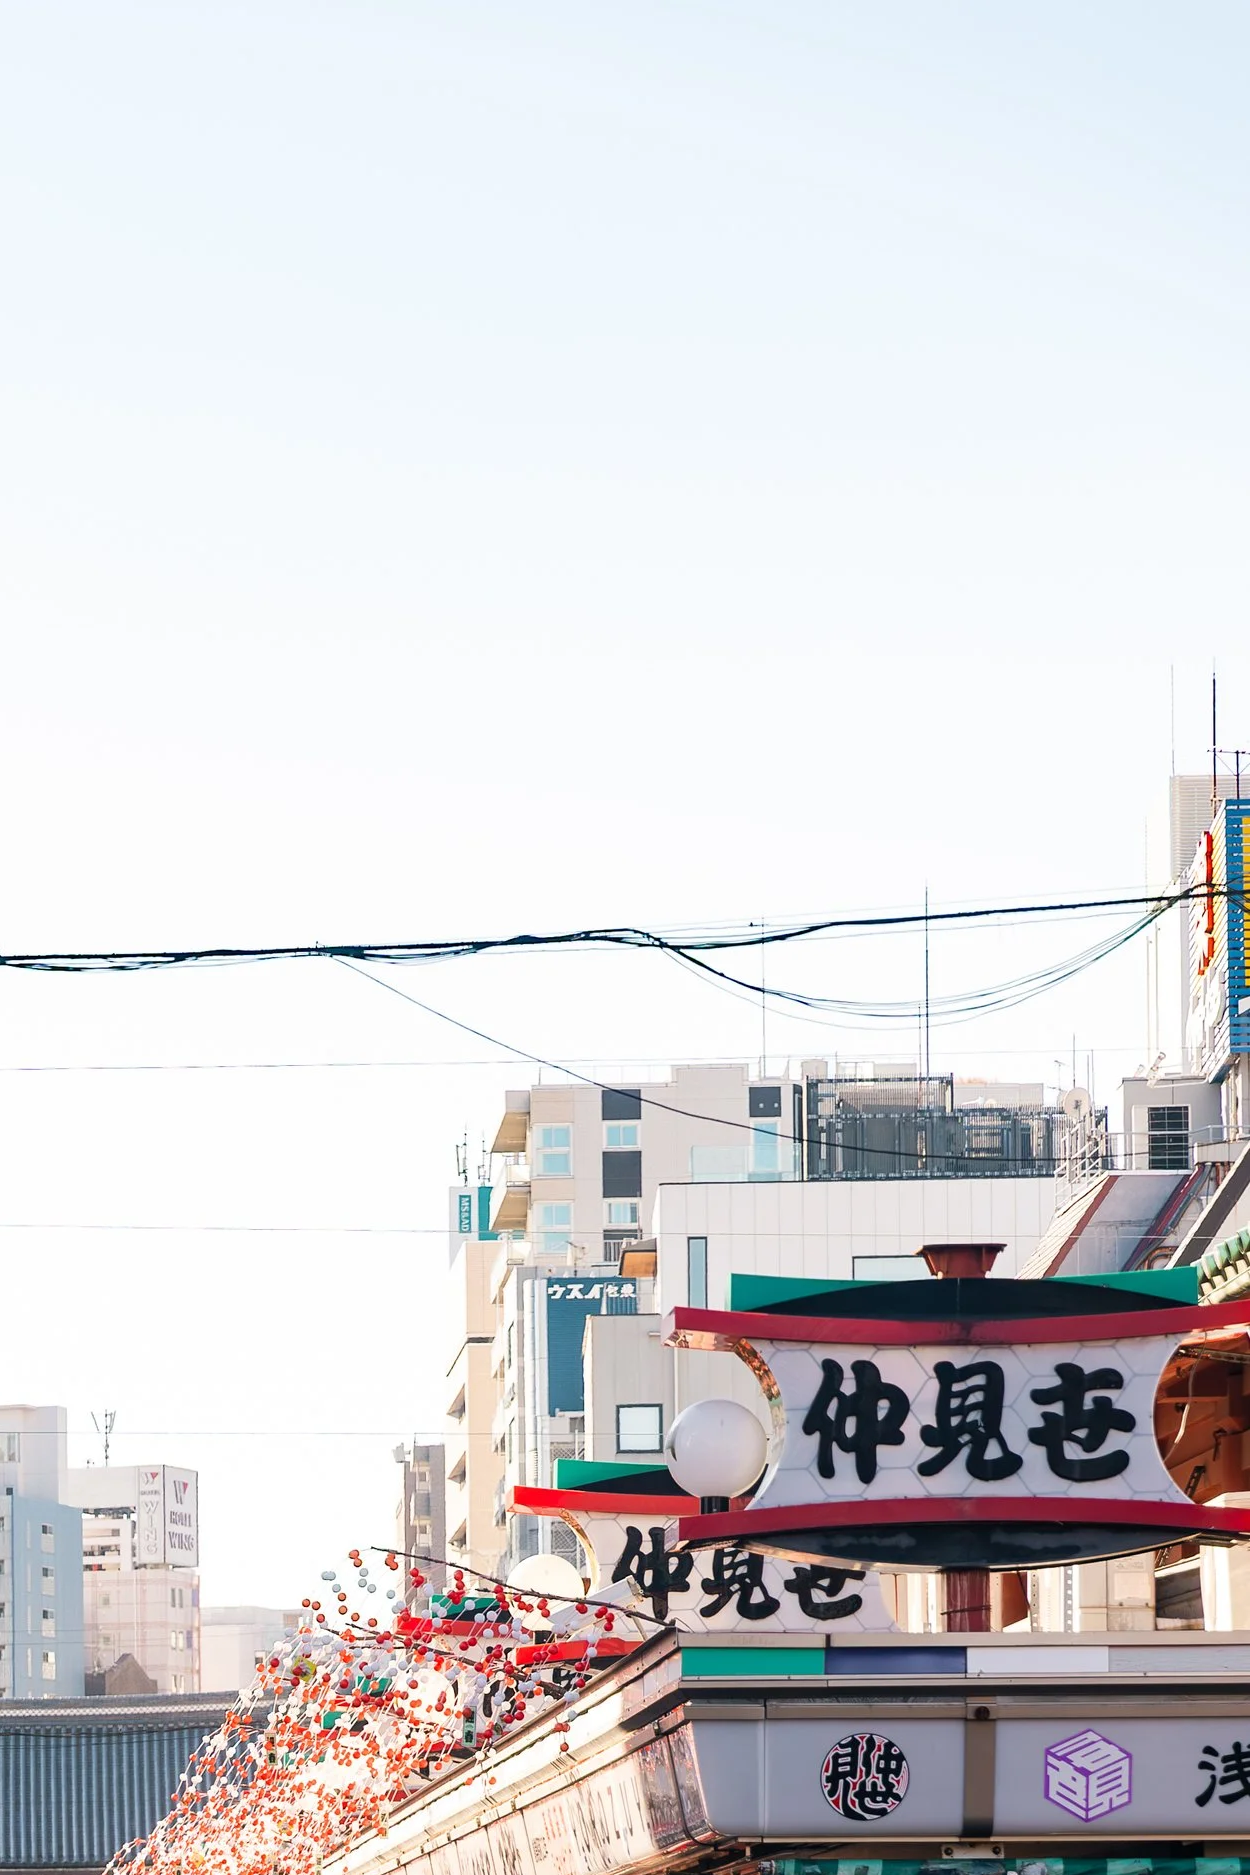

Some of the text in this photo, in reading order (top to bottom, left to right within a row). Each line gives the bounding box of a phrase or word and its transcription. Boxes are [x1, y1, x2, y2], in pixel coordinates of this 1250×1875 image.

[802, 1358, 1136, 1484] 仲見世
[612, 1526, 867, 1620] 仲見世
